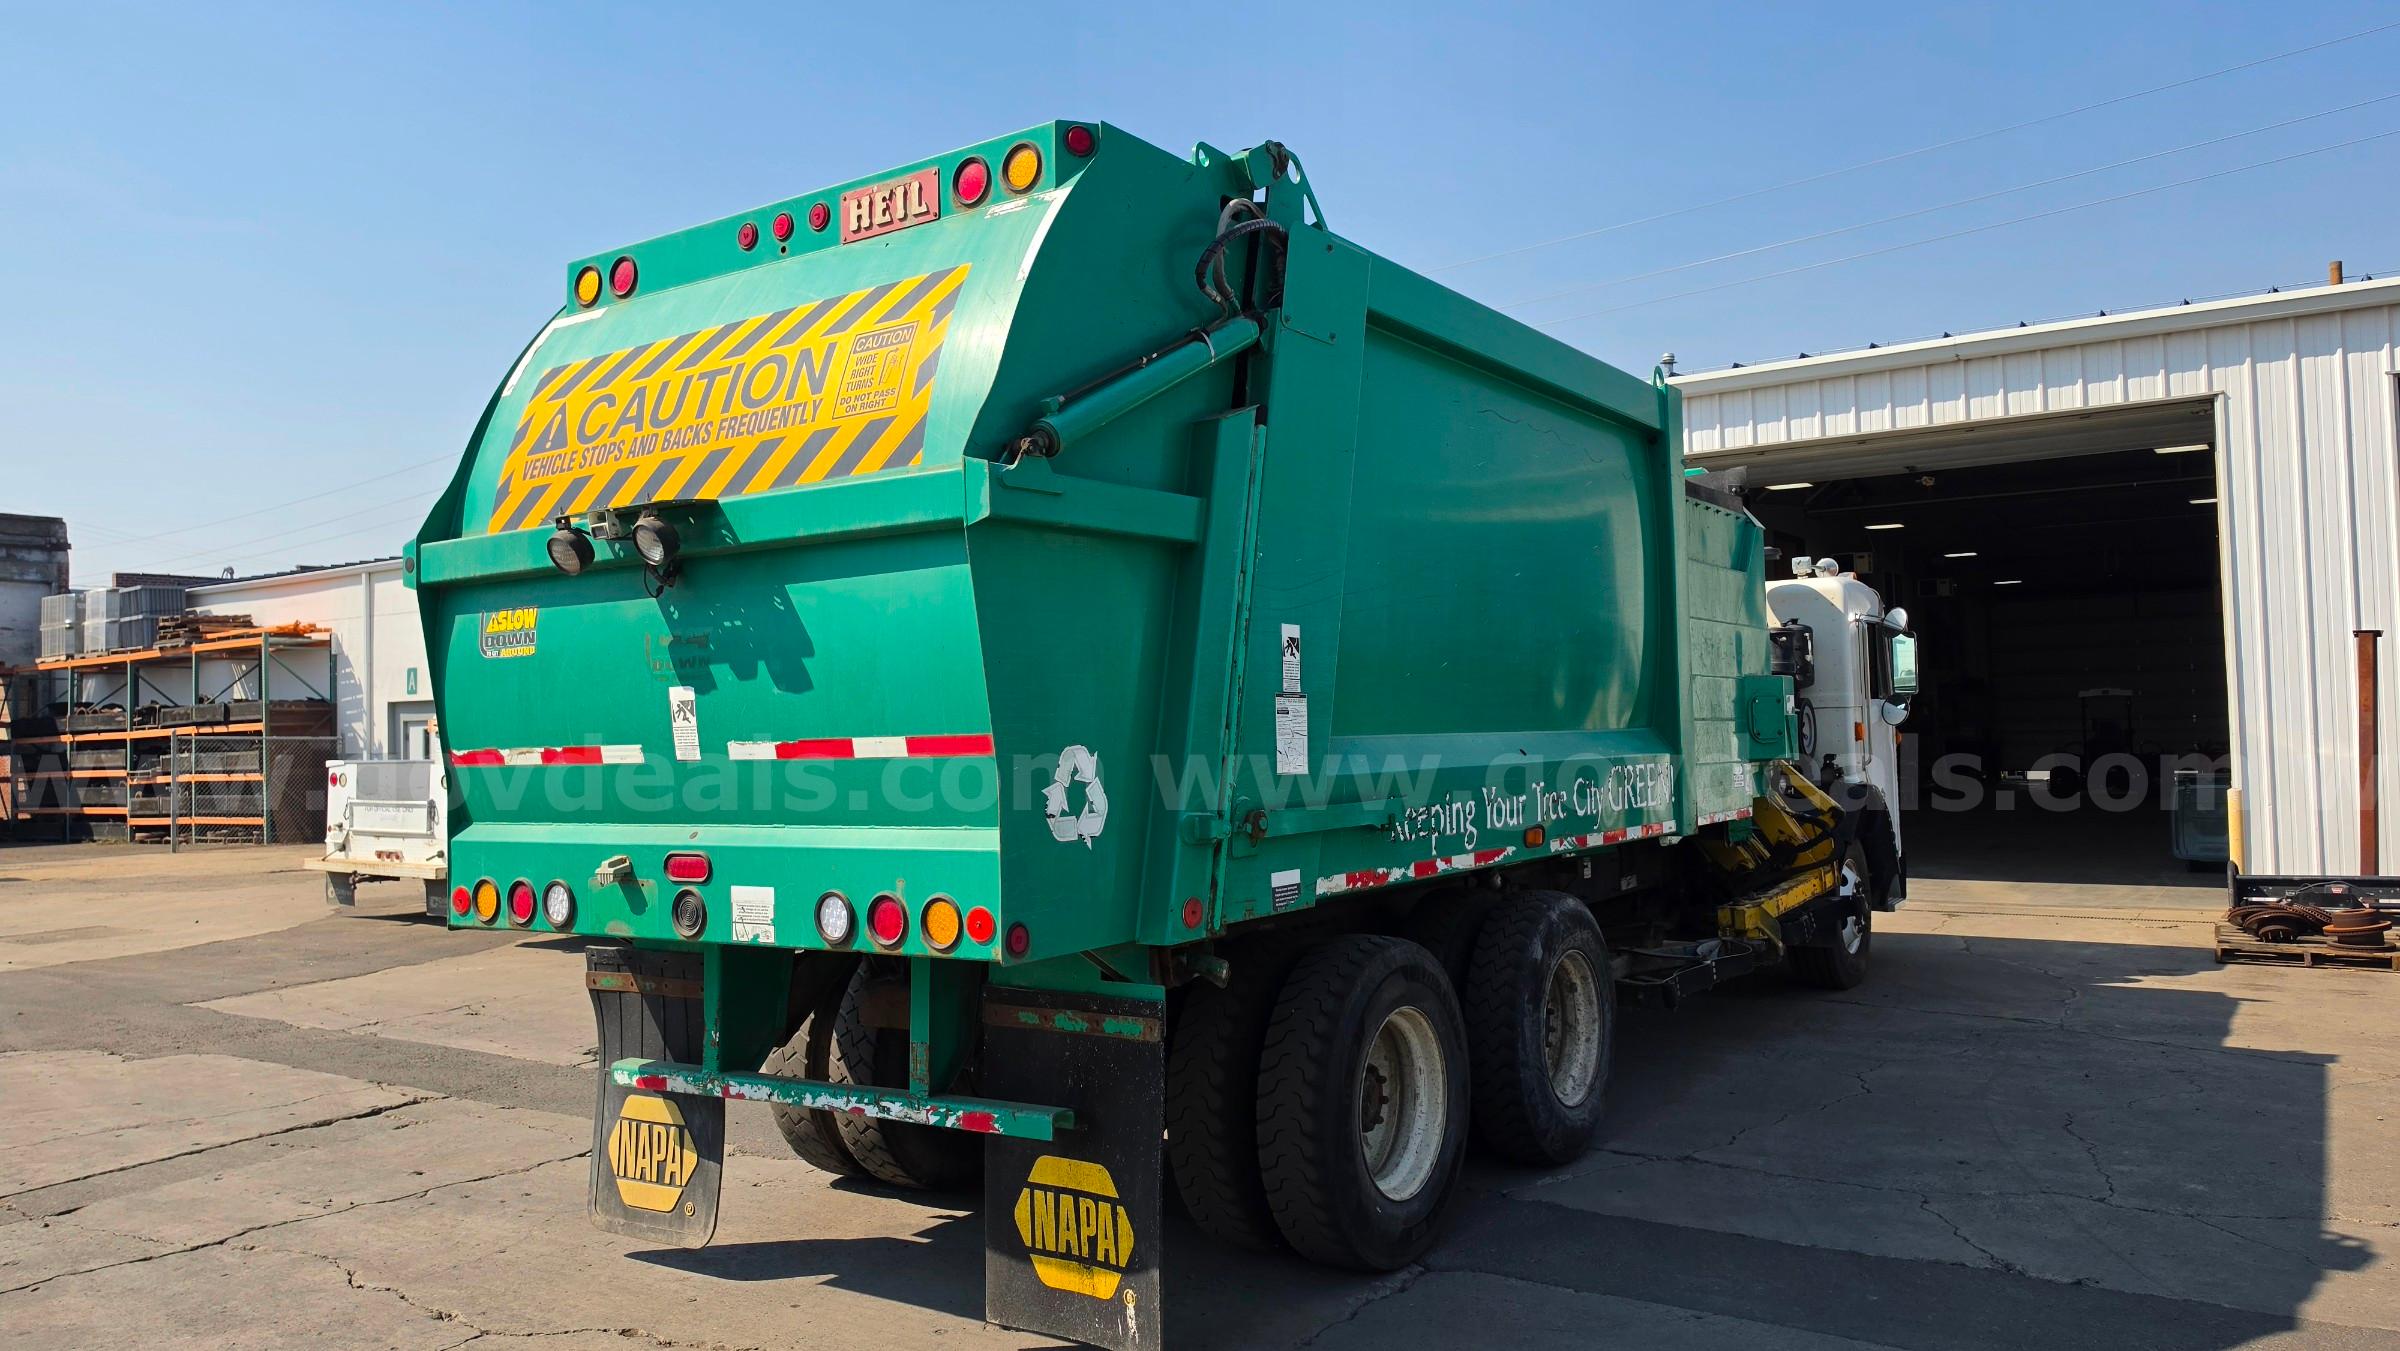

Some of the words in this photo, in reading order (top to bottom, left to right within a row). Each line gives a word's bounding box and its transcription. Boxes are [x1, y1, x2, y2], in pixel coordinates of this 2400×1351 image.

[849, 180, 930, 233] HEIL
[855, 327, 912, 352] CAUTION
[850, 365, 877, 380] RIGHT
[855, 353, 879, 368] WIDE
[576, 342, 837, 446] CAUTION
[840, 396, 852, 406] DO
[854, 391, 872, 402] NOT
[873, 387, 897, 400] PASS
[846, 377, 875, 393] TURNS
[845, 403, 858, 414] ON
[860, 398, 887, 411] RIGHT
[522, 452, 576, 481] VEHICLE
[579, 439, 624, 470] STOPS
[626, 433, 659, 459] AND
[661, 423, 713, 452] BACKS
[715, 398, 824, 442] FREQUENTLY
[497, 607, 538, 632] SLOW
[485, 630, 537, 649] DOWN
[408, 671, 416, 690] A
[1481, 786, 1526, 829] Your
[1574, 777, 1604, 829] City
[1608, 763, 1675, 812] GREEN!
[618, 1119, 682, 1186] NAPA
[1033, 1189, 1117, 1266] NAPA
